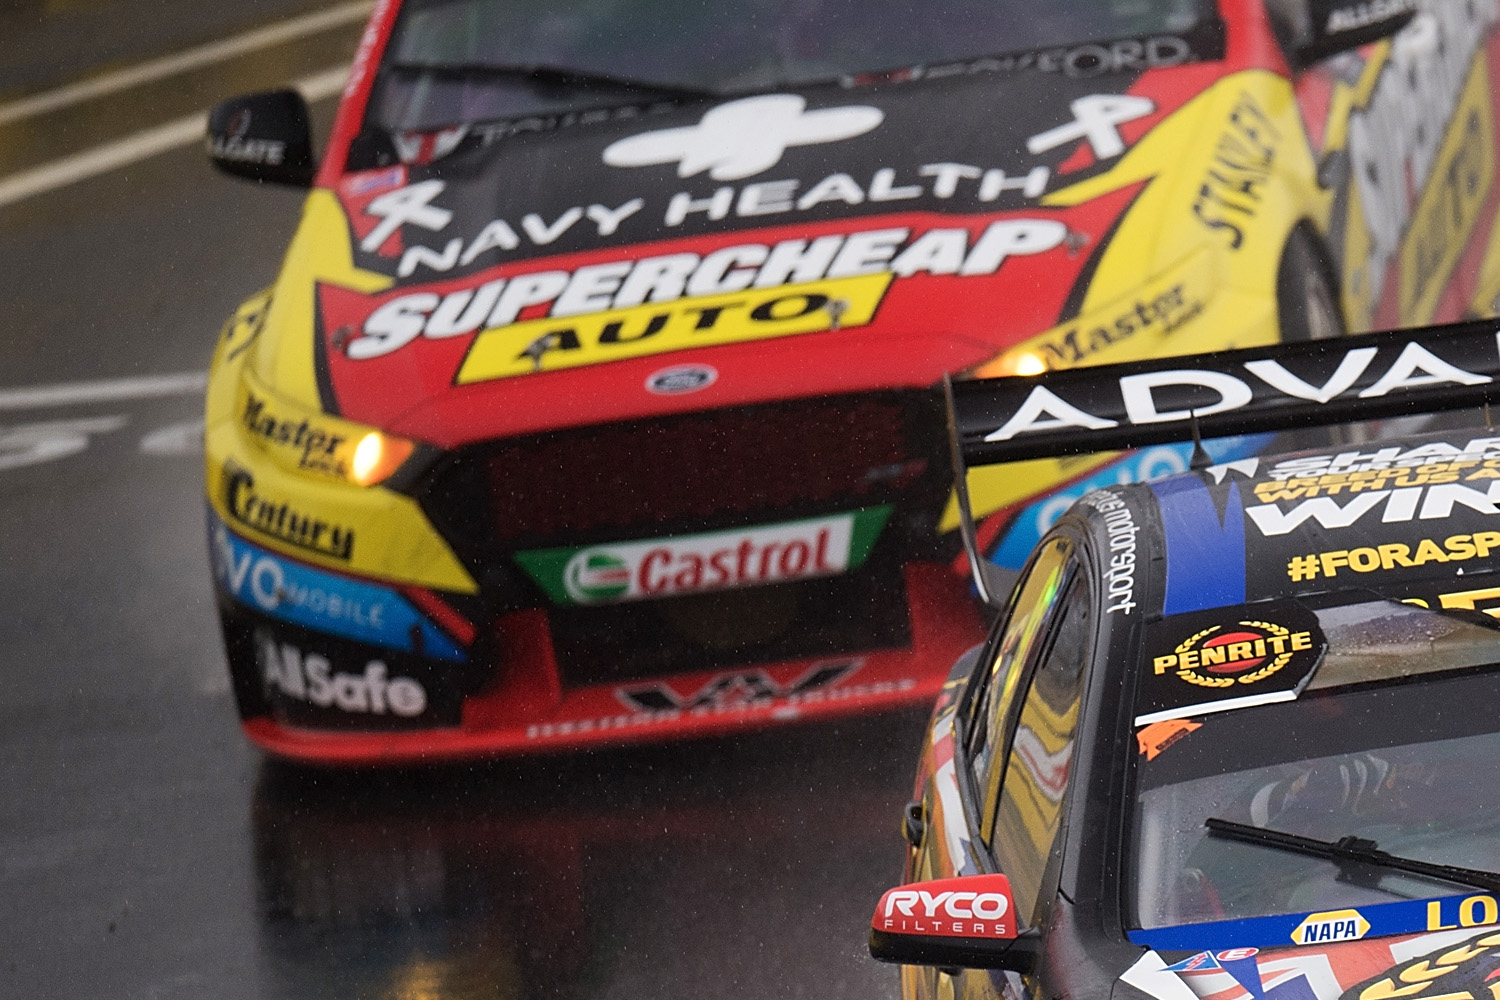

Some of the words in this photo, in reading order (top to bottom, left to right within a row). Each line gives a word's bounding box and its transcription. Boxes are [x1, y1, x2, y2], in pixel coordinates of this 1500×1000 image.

[398, 197, 645, 278] NAVY
[664, 161, 1052, 226] HEALTH
[346, 217, 1070, 361] SUPERCHEAP
[515, 291, 830, 368] AUTO
[1256, 478, 1387, 503] WITH
[1394, 473, 1460, 487] US
[637, 528, 833, 593] Castrol
[1102, 508, 1141, 615] motorsport
[1153, 629, 1314, 676] PENRITE
[884, 890, 1008, 919] RYCO
[884, 920, 1007, 935] FILTERS
[1304, 918, 1358, 943] NAPA
